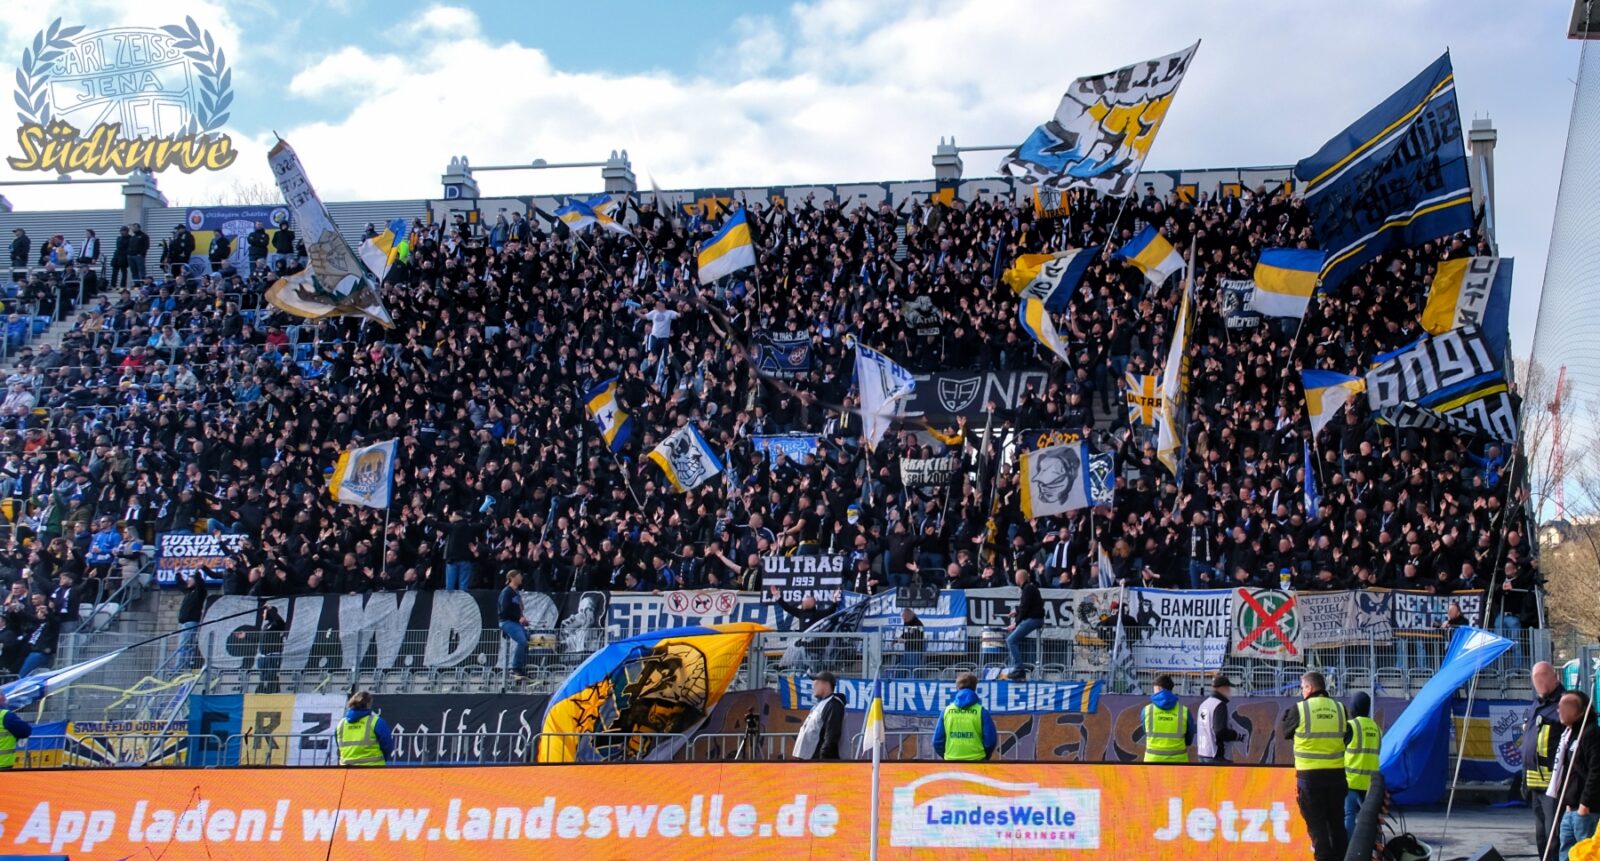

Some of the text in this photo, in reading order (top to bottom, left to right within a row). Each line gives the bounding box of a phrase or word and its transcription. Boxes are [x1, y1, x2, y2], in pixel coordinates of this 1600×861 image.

[764, 555, 844, 573] ULTRAS
[791, 576, 815, 587] 1993
[1161, 598, 1232, 617] BAMBULE
[1301, 594, 1350, 605] NUTZE DAS
[1395, 593, 1480, 613] REFUGEES
[969, 597, 1075, 627] ULTAS
[1309, 604, 1344, 615] SPIEL
[1313, 620, 1343, 631] DEIN
[801, 680, 957, 711] SDKURVE
[950, 731, 974, 739] ORDNER
[14, 801, 116, 853] App
[127, 799, 291, 843] laden!
[301, 794, 840, 843] www.landeswelle.de
[926, 805, 1077, 826] LandesWelle
[1154, 797, 1291, 843] Jetzt
[996, 829, 1077, 840] THÜRINGEN
